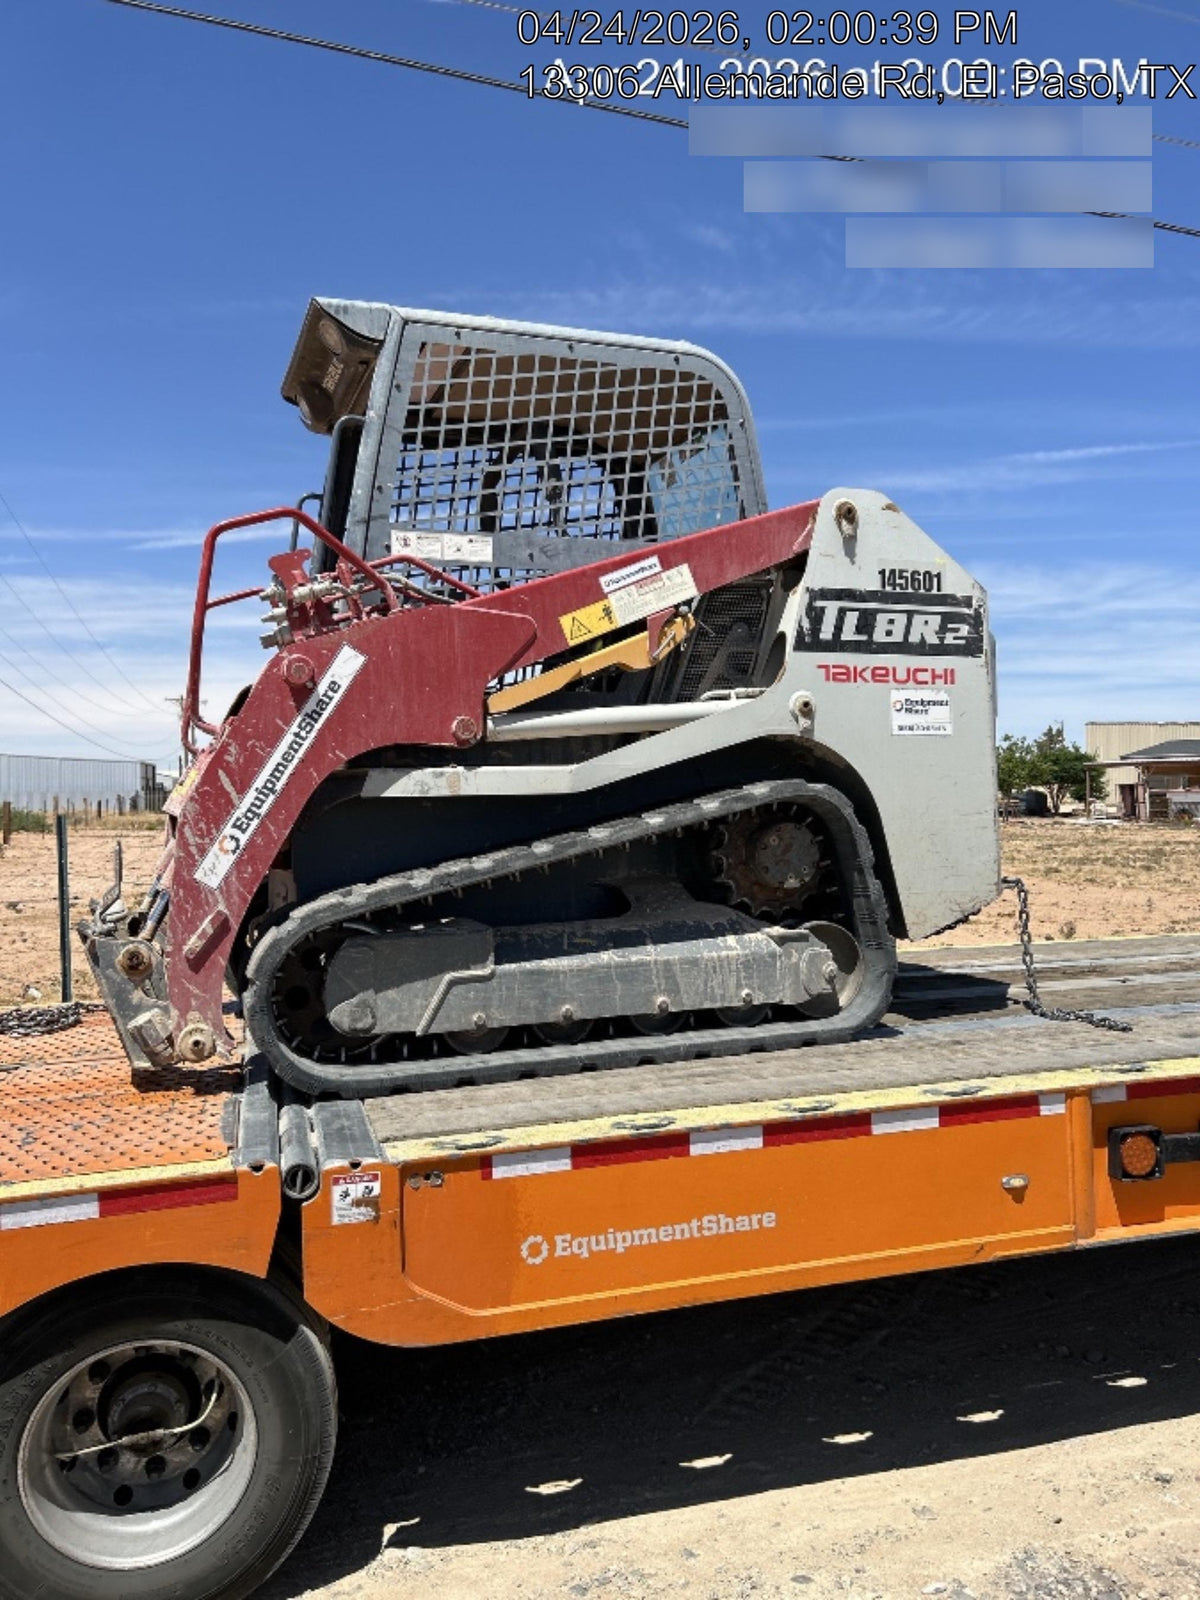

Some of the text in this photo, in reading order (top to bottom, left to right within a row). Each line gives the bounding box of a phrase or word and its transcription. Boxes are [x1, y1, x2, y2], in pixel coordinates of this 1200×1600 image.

[878, 568, 941, 592] 145601
[816, 664, 956, 685] TAKEUCHI
[230, 679, 341, 835] EquipmentShare
[554, 1211, 777, 1260] EquipmentShare
